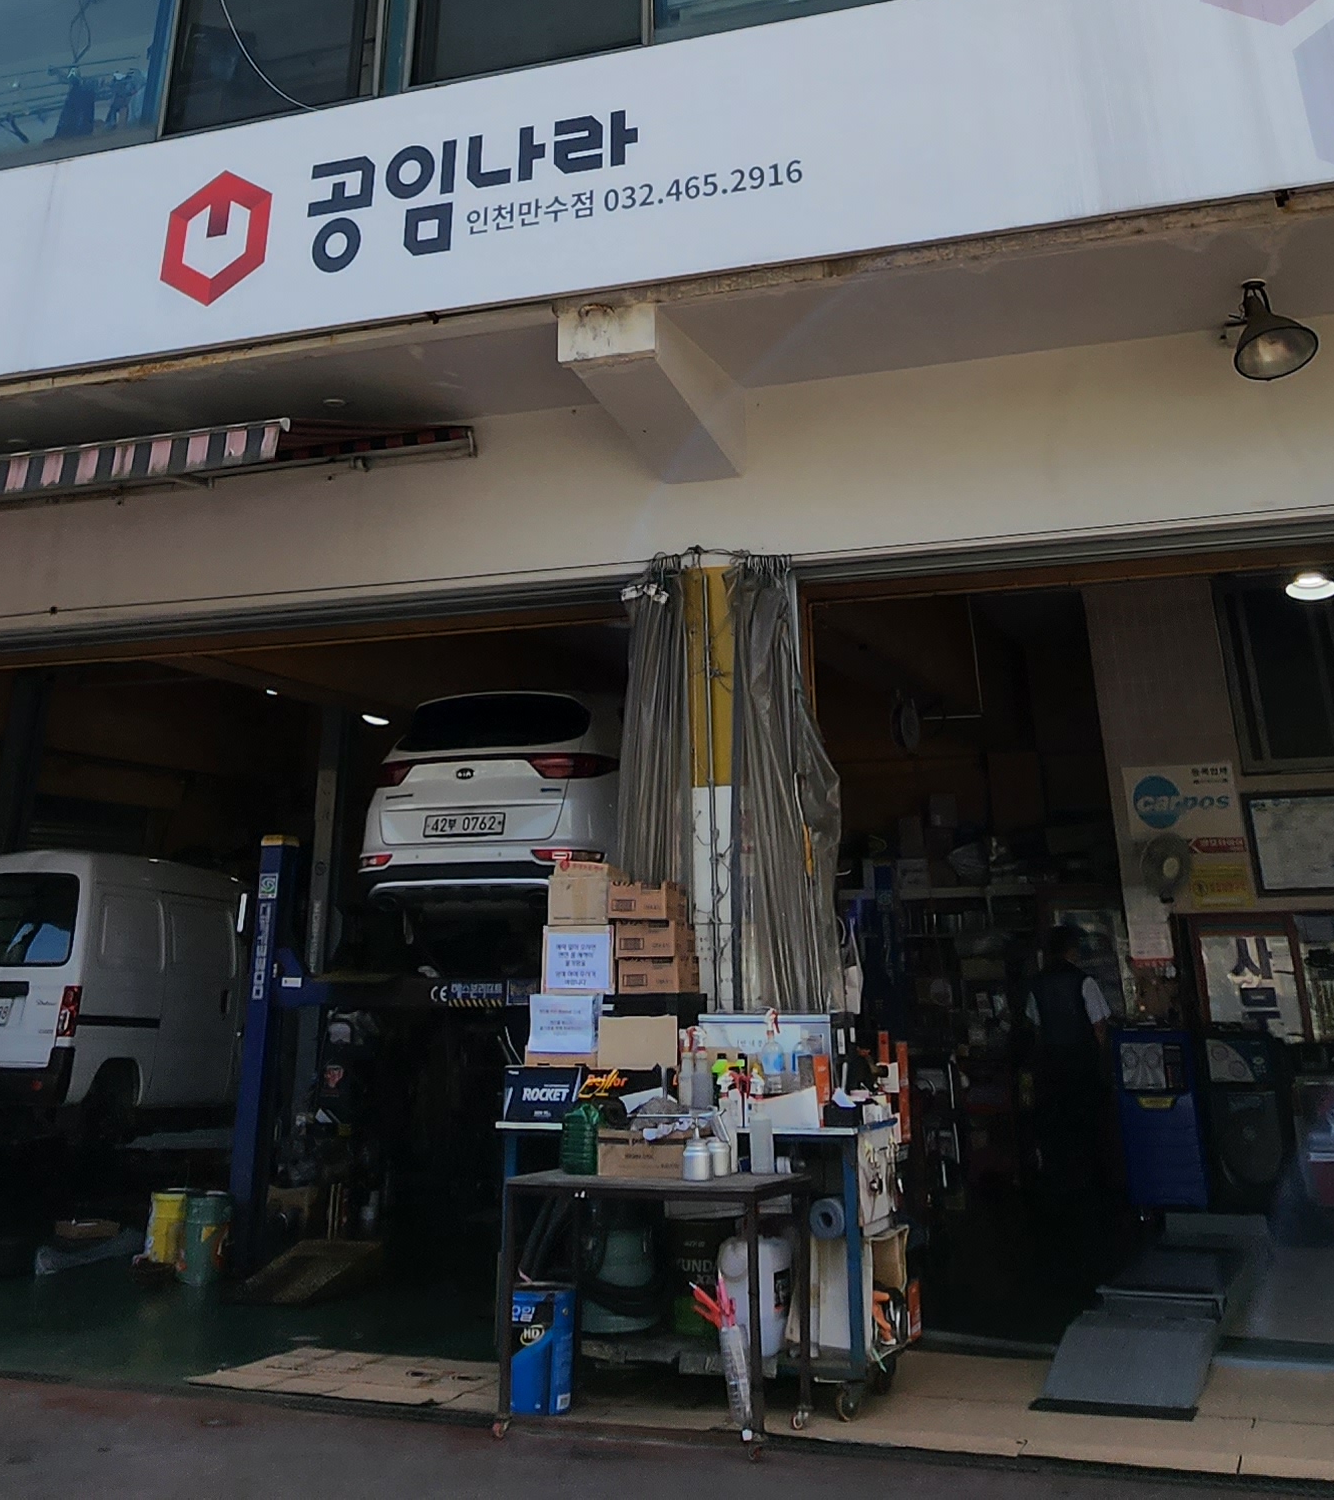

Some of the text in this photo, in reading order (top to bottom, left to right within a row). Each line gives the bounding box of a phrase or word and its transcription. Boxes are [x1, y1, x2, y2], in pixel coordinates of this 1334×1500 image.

[306, 109, 640, 274] 공임나라
[466, 159, 804, 235] 인천만수점 032.465.2916
[461, 815, 497, 832] 0762
[521, 1086, 570, 1102] ROCKET
